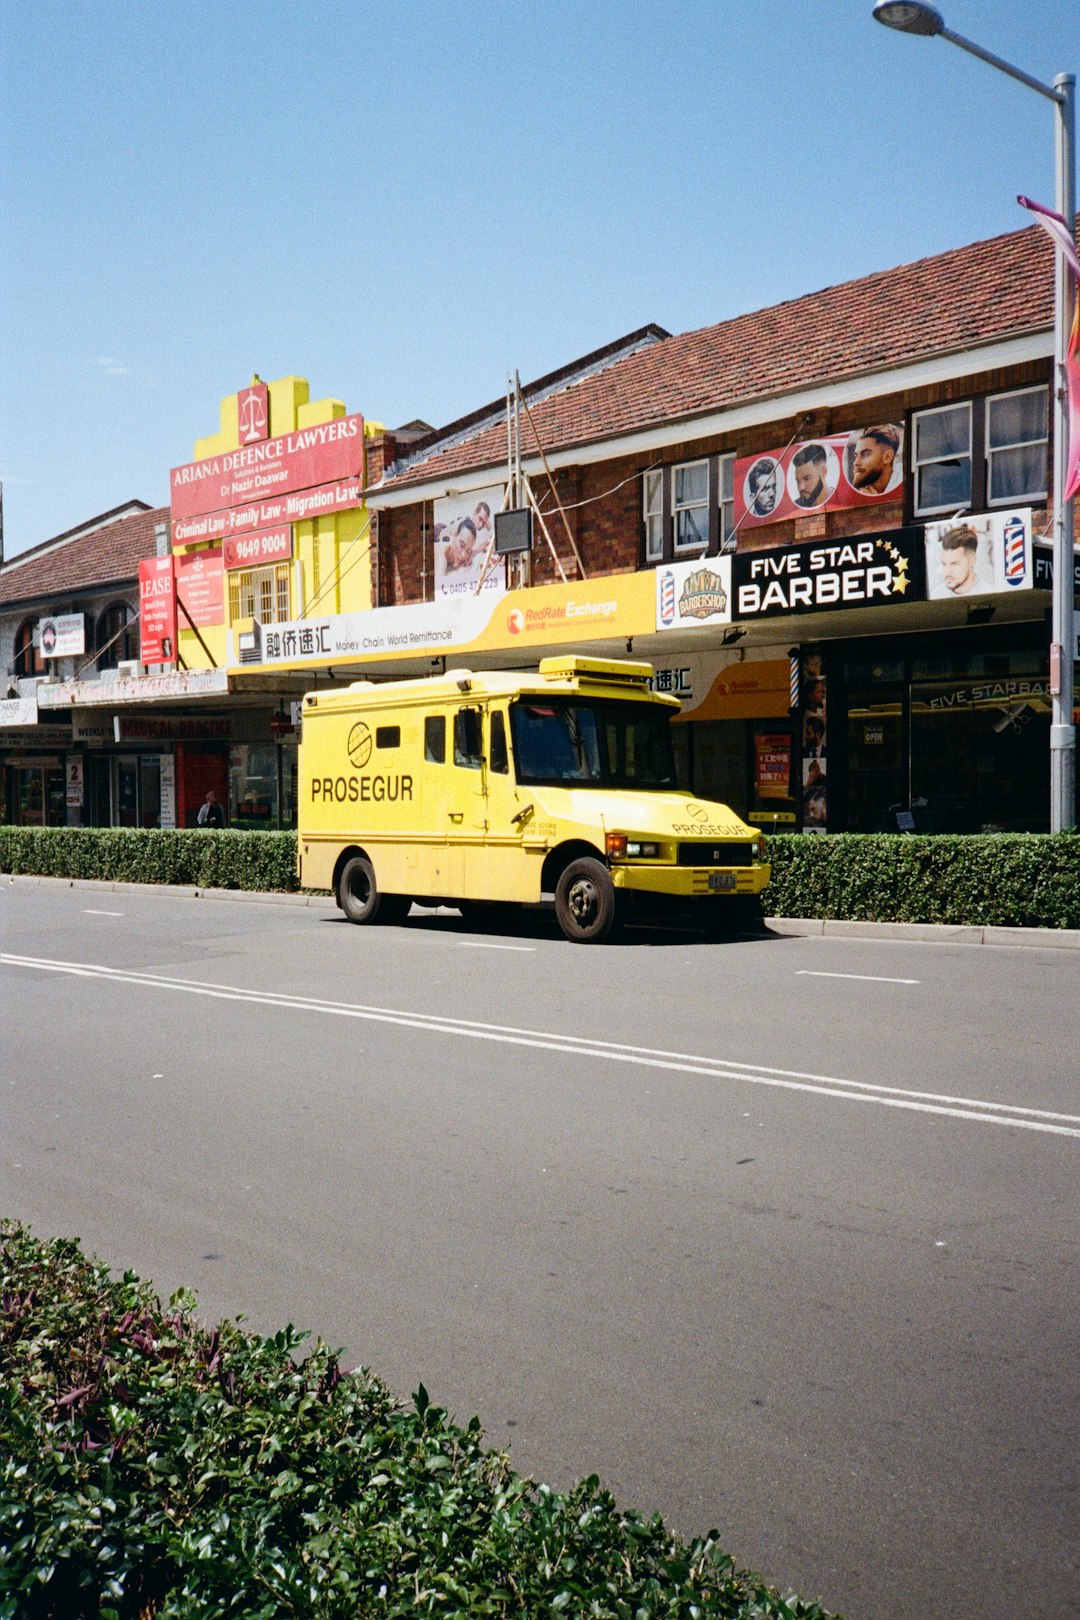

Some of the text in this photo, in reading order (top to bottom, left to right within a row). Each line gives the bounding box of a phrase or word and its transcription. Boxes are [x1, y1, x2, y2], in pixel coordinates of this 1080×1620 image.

[174, 418, 357, 486] ARIANA DEFENCE LAWYERS
[221, 469, 289, 497] Dr Nazir Daawar
[175, 518, 207, 540] Criminal
[208, 514, 225, 532] Law
[230, 507, 259, 529] Family
[261, 502, 280, 521] Law
[287, 490, 334, 516] Migration
[336, 485, 359, 502] Law
[236, 534, 286, 559] 9649 9004
[751, 542, 874, 579] FIVE STAR
[140, 576, 172, 599] LEASE
[450, 582, 467, 595] 0405
[484, 577, 499, 590] 228
[738, 566, 893, 614] BARBER
[679, 593, 726, 614] BARBERSHOP
[266, 625, 331, 659] 融侨速汇
[335, 629, 453, 652] Money Chain World Remittance
[929, 690, 967, 710] FIVE
[972, 682, 1016, 699] STAR
[78, 727, 105, 738] WEEKLY
[123, 719, 173, 737] MEDICAL
[179, 719, 232, 736] PRACTICE
[866, 732, 883, 742] OPEN
[70, 765, 79, 781] 2
[312, 775, 413, 802] PROSEGUR
[672, 823, 749, 836] PROSEGUR
